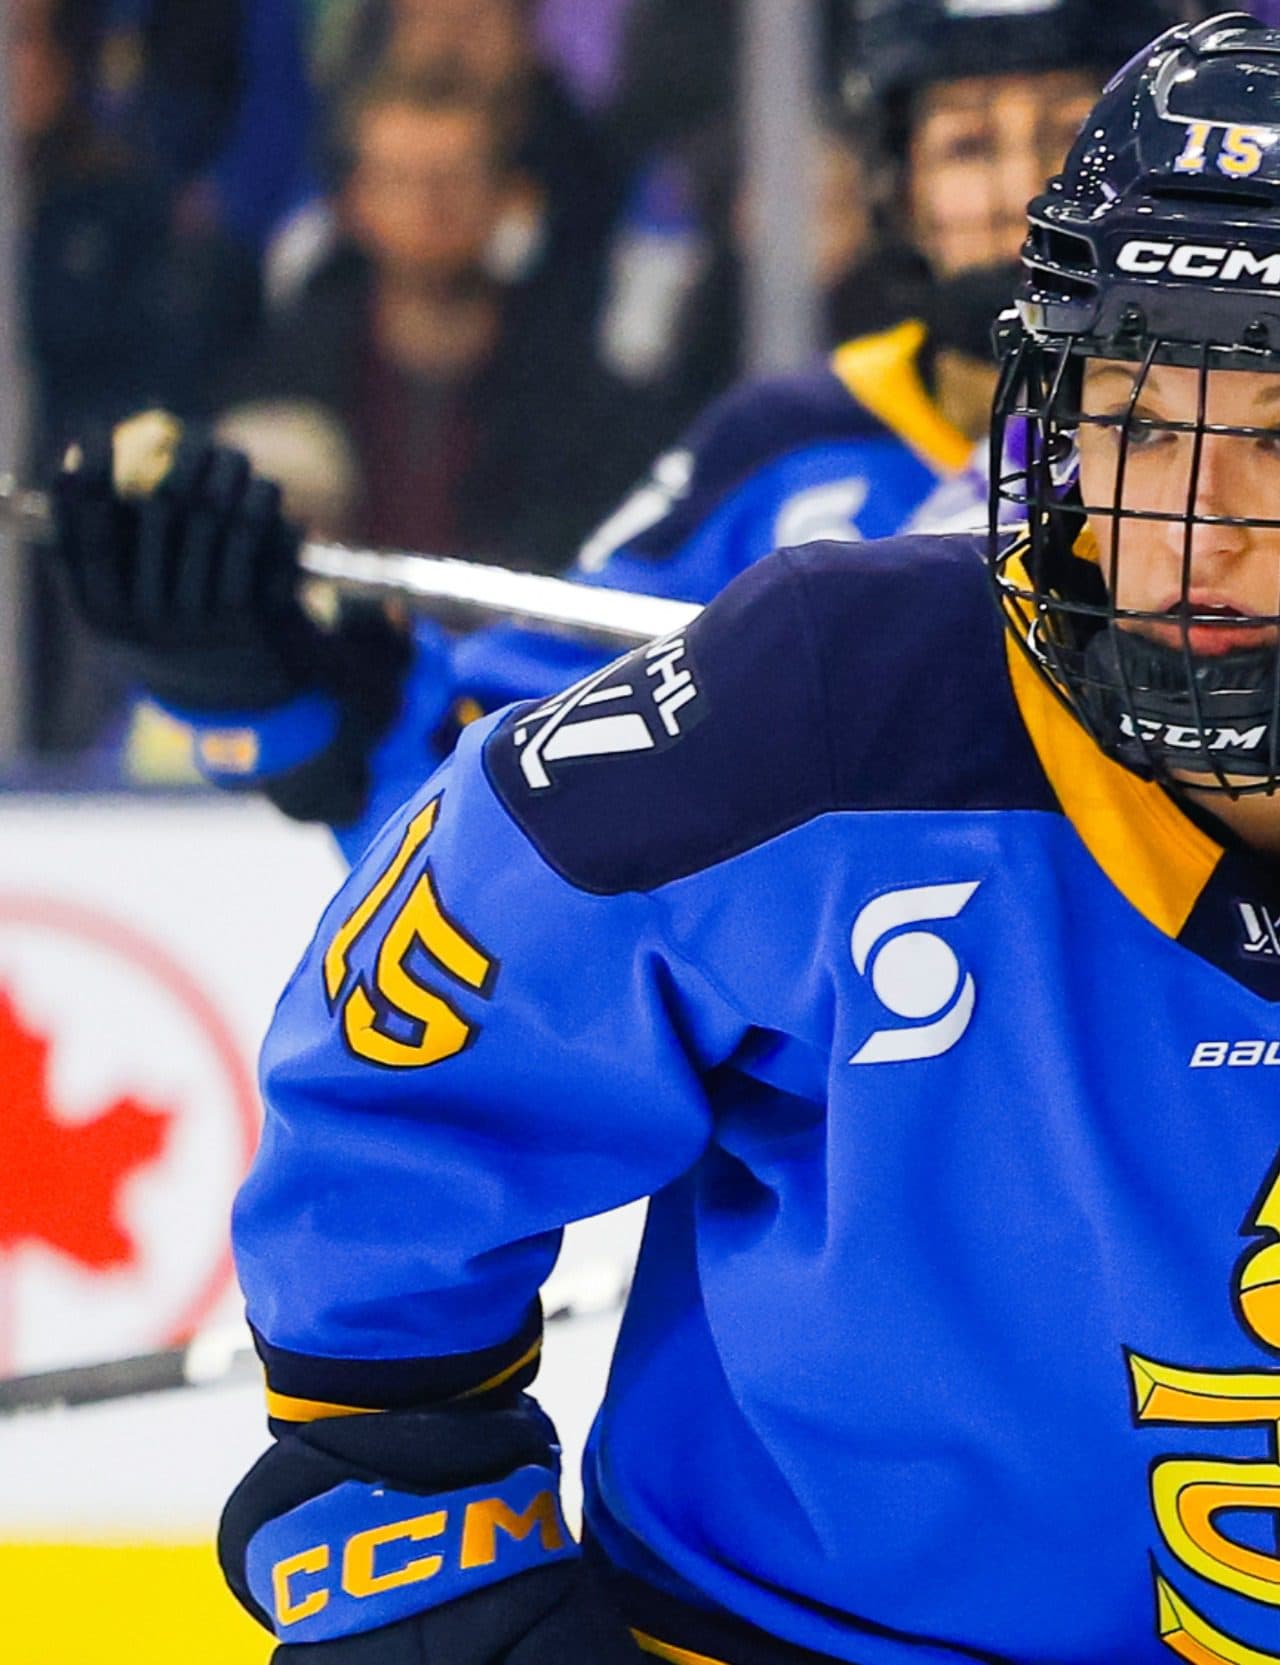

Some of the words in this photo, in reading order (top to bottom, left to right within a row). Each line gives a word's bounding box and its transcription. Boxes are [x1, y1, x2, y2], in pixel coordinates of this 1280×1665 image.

[1173, 123, 1264, 177] 15
[1119, 713, 1267, 750] CCM
[322, 788, 500, 1072] 15
[273, 1489, 565, 1627] CCM
